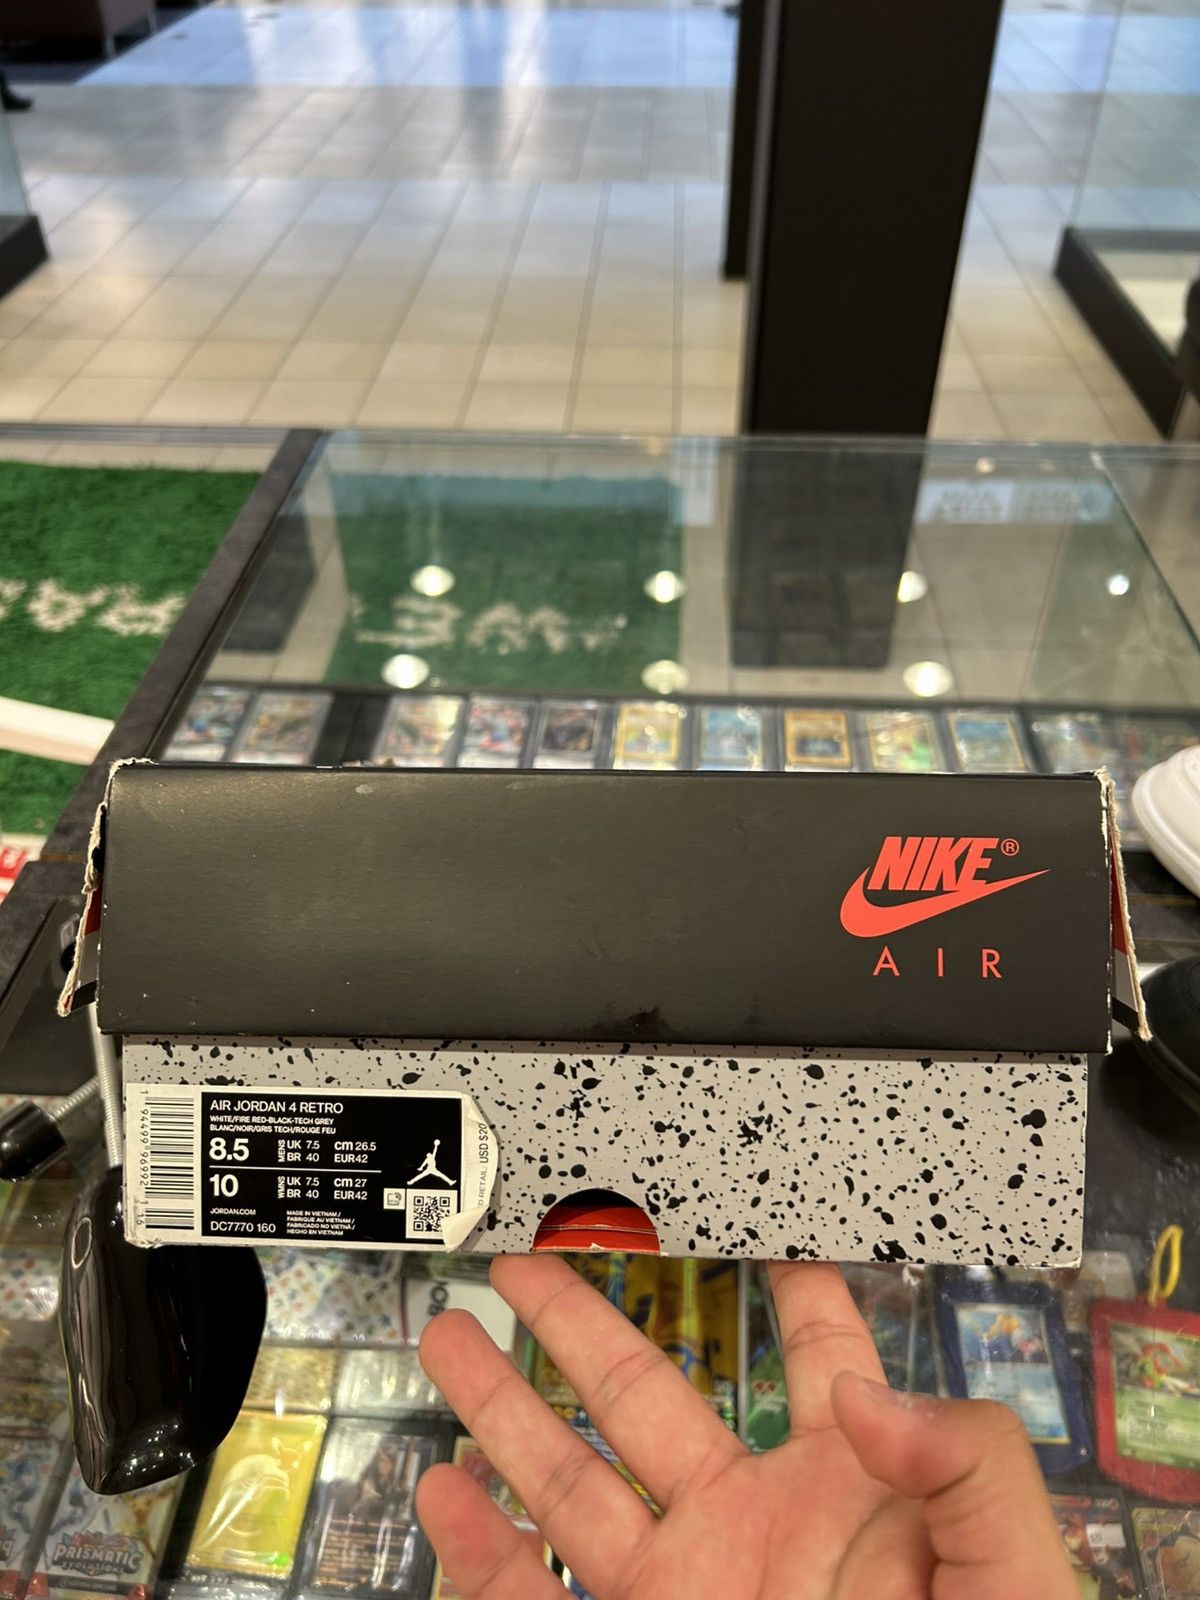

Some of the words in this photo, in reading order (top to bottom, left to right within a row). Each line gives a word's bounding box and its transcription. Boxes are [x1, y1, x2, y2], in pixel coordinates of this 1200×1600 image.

[872, 946, 1002, 978] AIR
[210, 1100, 231, 1111] AIR
[234, 1100, 286, 1112] JORDAN
[289, 1102, 296, 1112] 4
[300, 1102, 344, 1114] RETRO
[210, 1115, 251, 1123] WHITE/FIRE
[252, 1116, 313, 1125] RED-BLACK-TECH
[209, 1124, 272, 1132] BLANC/NOIR/GRIS
[274, 1125, 320, 1134] TECH/ROUGE
[209, 1137, 249, 1161] 8.5
[278, 1139, 286, 1163] MENS
[287, 1140, 301, 1149] UK
[306, 1140, 320, 1149] 7.5
[334, 1141, 353, 1150] cm
[355, 1142, 377, 1151] 26.5
[287, 1152, 301, 1162] BR
[306, 1153, 320, 1162] 40
[479, 1143, 489, 1164] USD
[209, 1174, 239, 1197] 10
[287, 1177, 301, 1186] UK
[305, 1177, 320, 1186] 7.5
[334, 1178, 353, 1187] cm
[355, 1178, 368, 1188] 27
[287, 1189, 301, 1198] BR
[305, 1190, 320, 1199] 40
[210, 1208, 256, 1216] JORDAN.COM
[210, 1221, 254, 1232] DC7770
[257, 1223, 276, 1233] 160
[53, 1543, 143, 1570] PRISMATIC
